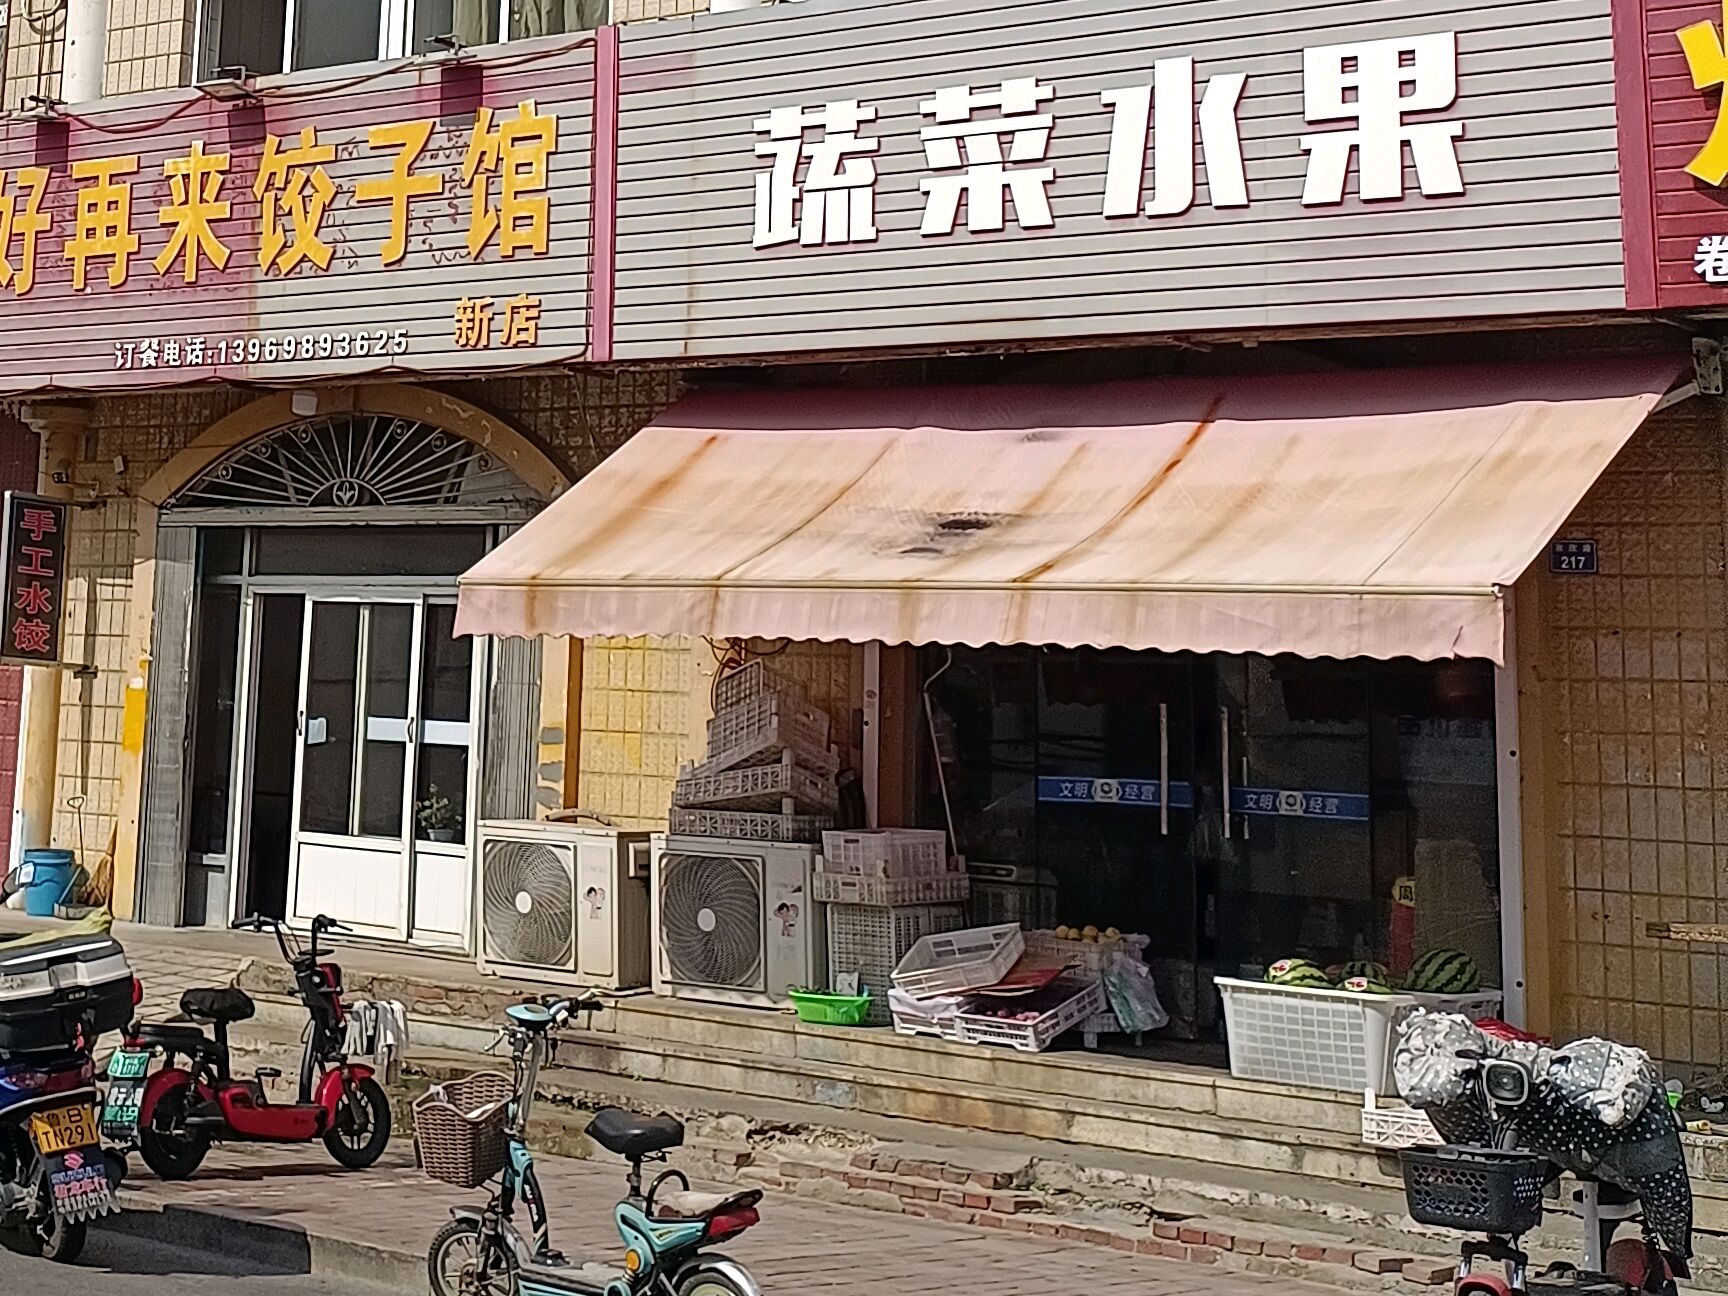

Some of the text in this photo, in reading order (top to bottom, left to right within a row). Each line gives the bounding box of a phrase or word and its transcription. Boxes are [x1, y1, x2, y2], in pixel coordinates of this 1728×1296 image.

[752, 30, 1466, 250] 蔬菜水果
[454, 292, 542, 349] 新店
[1560, 555, 1586, 570] 217
[12, 507, 57, 654] 手工水饺
[1058, 781, 1156, 802] 文明 经营
[1243, 792, 1340, 814] 文明 经营
[42, 1125, 95, 1150] TN291
